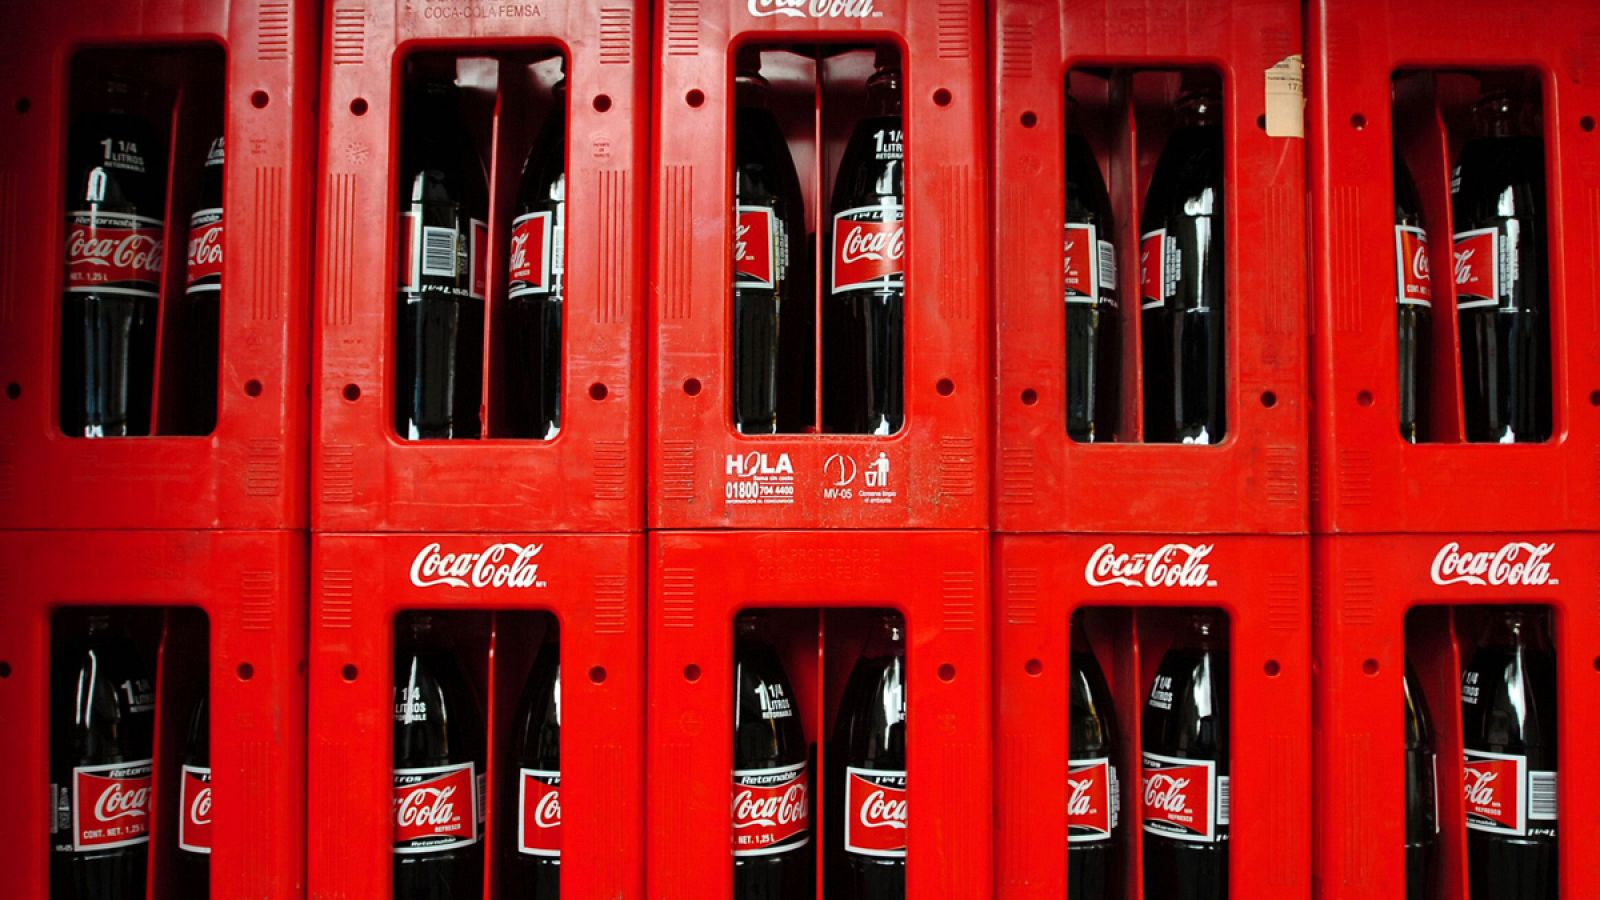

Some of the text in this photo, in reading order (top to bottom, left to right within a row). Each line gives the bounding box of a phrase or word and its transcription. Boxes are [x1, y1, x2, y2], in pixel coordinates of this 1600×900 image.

[497, 4, 540, 17] FEMSA
[100, 137, 138, 160] 1 1/4
[873, 129, 885, 153] 1
[883, 143, 903, 153] LITR
[726, 451, 794, 477] HOLA
[726, 481, 794, 499] 01800 704 4400
[823, 488, 853, 500] MV-05
[410, 543, 543, 587] Coca-Cola
[1085, 543, 1214, 587] Coca-Cola
[1430, 542, 1555, 585] Coca-Cola
[120, 679, 135, 705] 1
[769, 683, 784, 698] 1/4
[395, 702, 426, 713] LITOS
[394, 775, 422, 784] tros
[741, 772, 797, 785] Retornable
